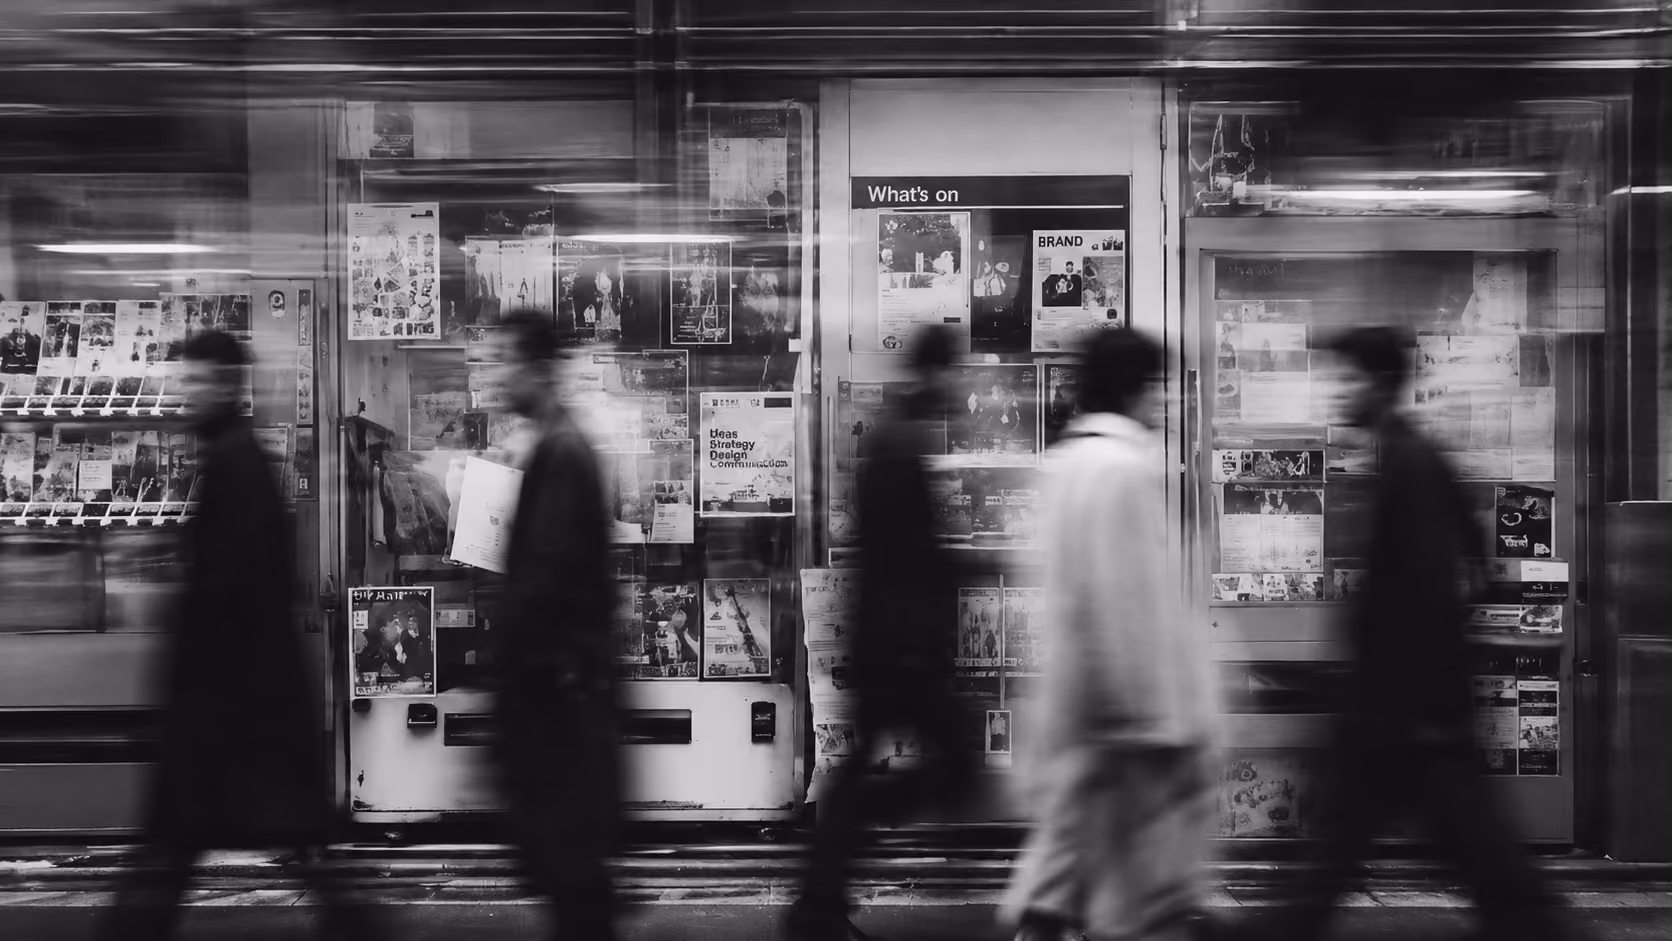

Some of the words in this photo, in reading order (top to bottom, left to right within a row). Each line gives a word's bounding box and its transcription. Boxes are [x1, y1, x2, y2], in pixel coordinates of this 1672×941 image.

[867, 185, 929, 202] What's
[935, 189, 959, 202] on
[1038, 235, 1083, 247] BRAND
[709, 439, 756, 451] Strategy
[709, 450, 748, 461] Design
